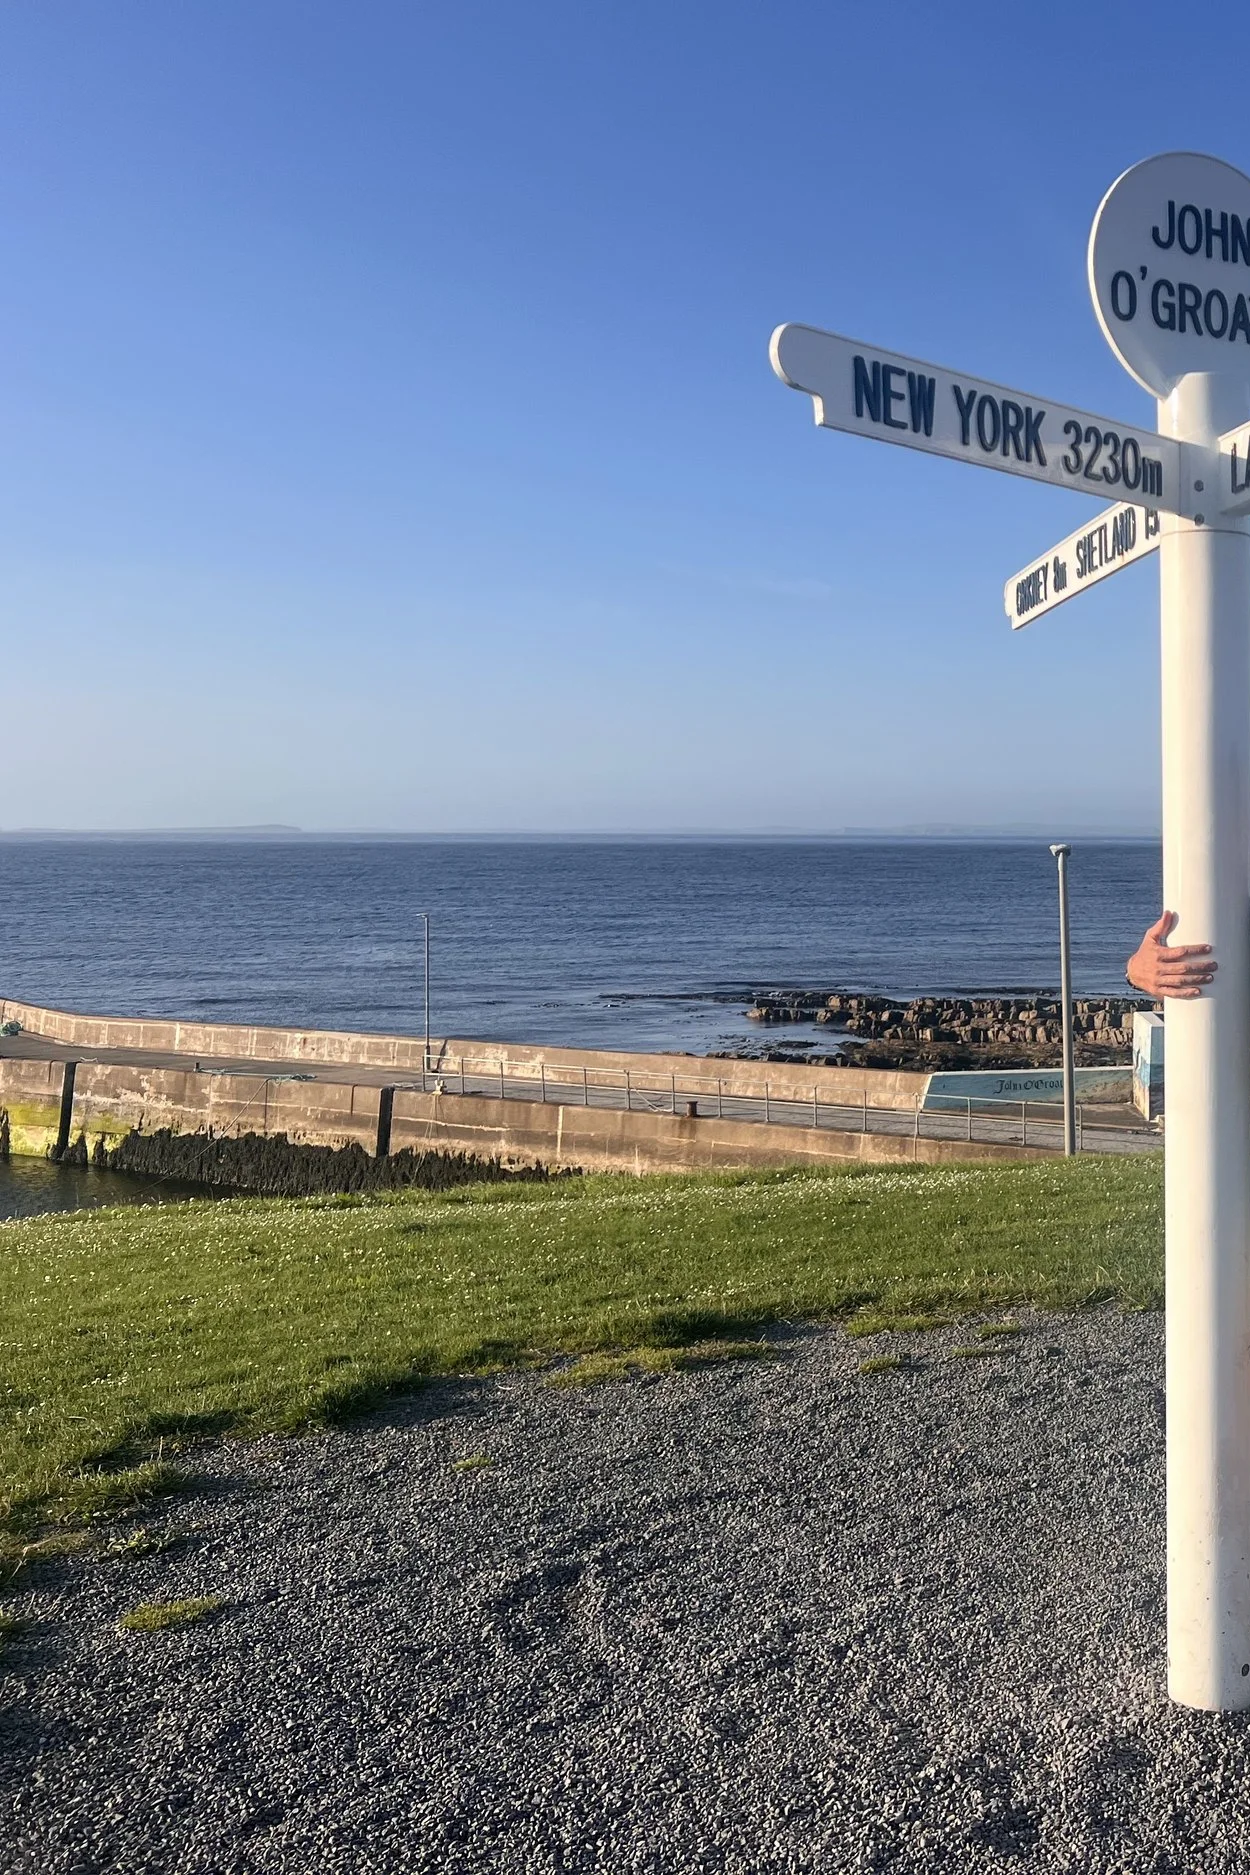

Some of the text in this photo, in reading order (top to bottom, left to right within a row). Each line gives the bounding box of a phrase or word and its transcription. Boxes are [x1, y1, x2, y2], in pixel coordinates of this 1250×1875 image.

[853, 355, 1163, 497] NEW YORK 3230m
[1076, 506, 1136, 579] SHETLAND
